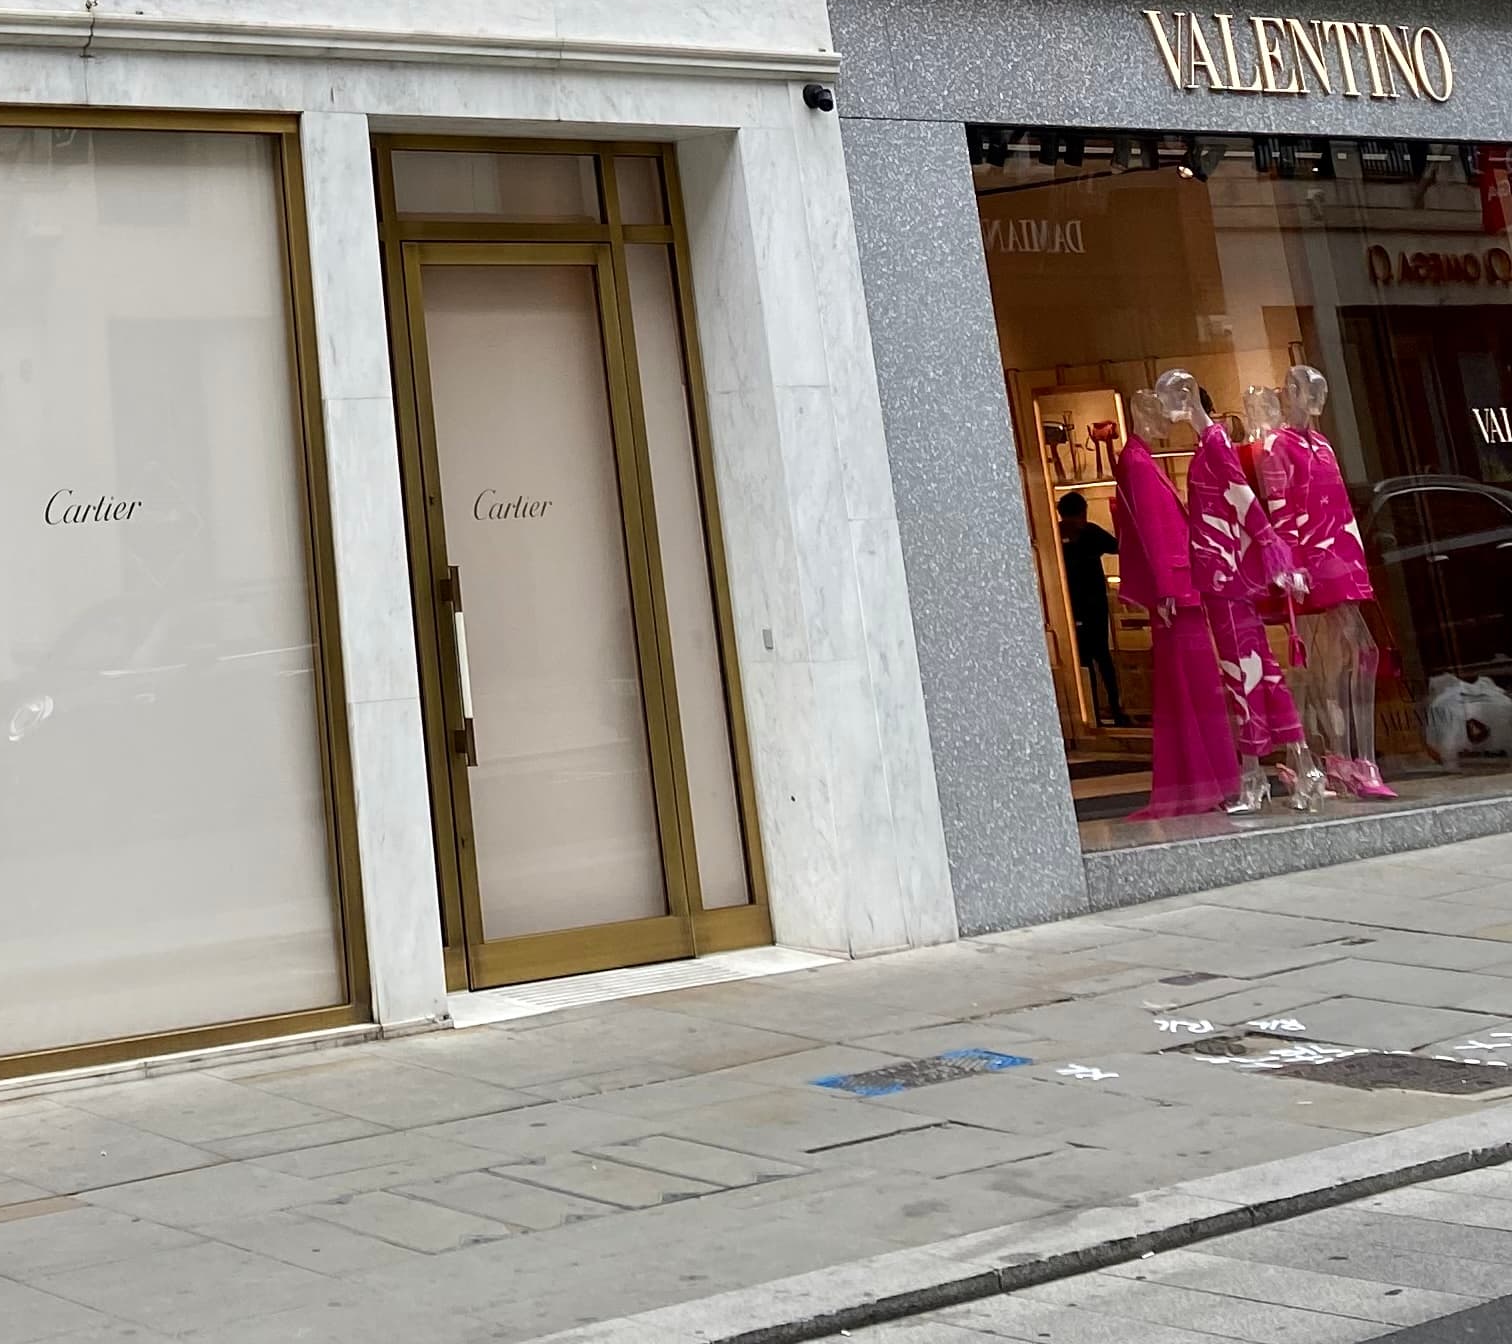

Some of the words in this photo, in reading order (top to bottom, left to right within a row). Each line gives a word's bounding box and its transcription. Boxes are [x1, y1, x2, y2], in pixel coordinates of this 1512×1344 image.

[1143, 10, 1453, 102] VALENTINO
[44, 488, 142, 526] Cartier
[473, 488, 553, 521] Cartier
